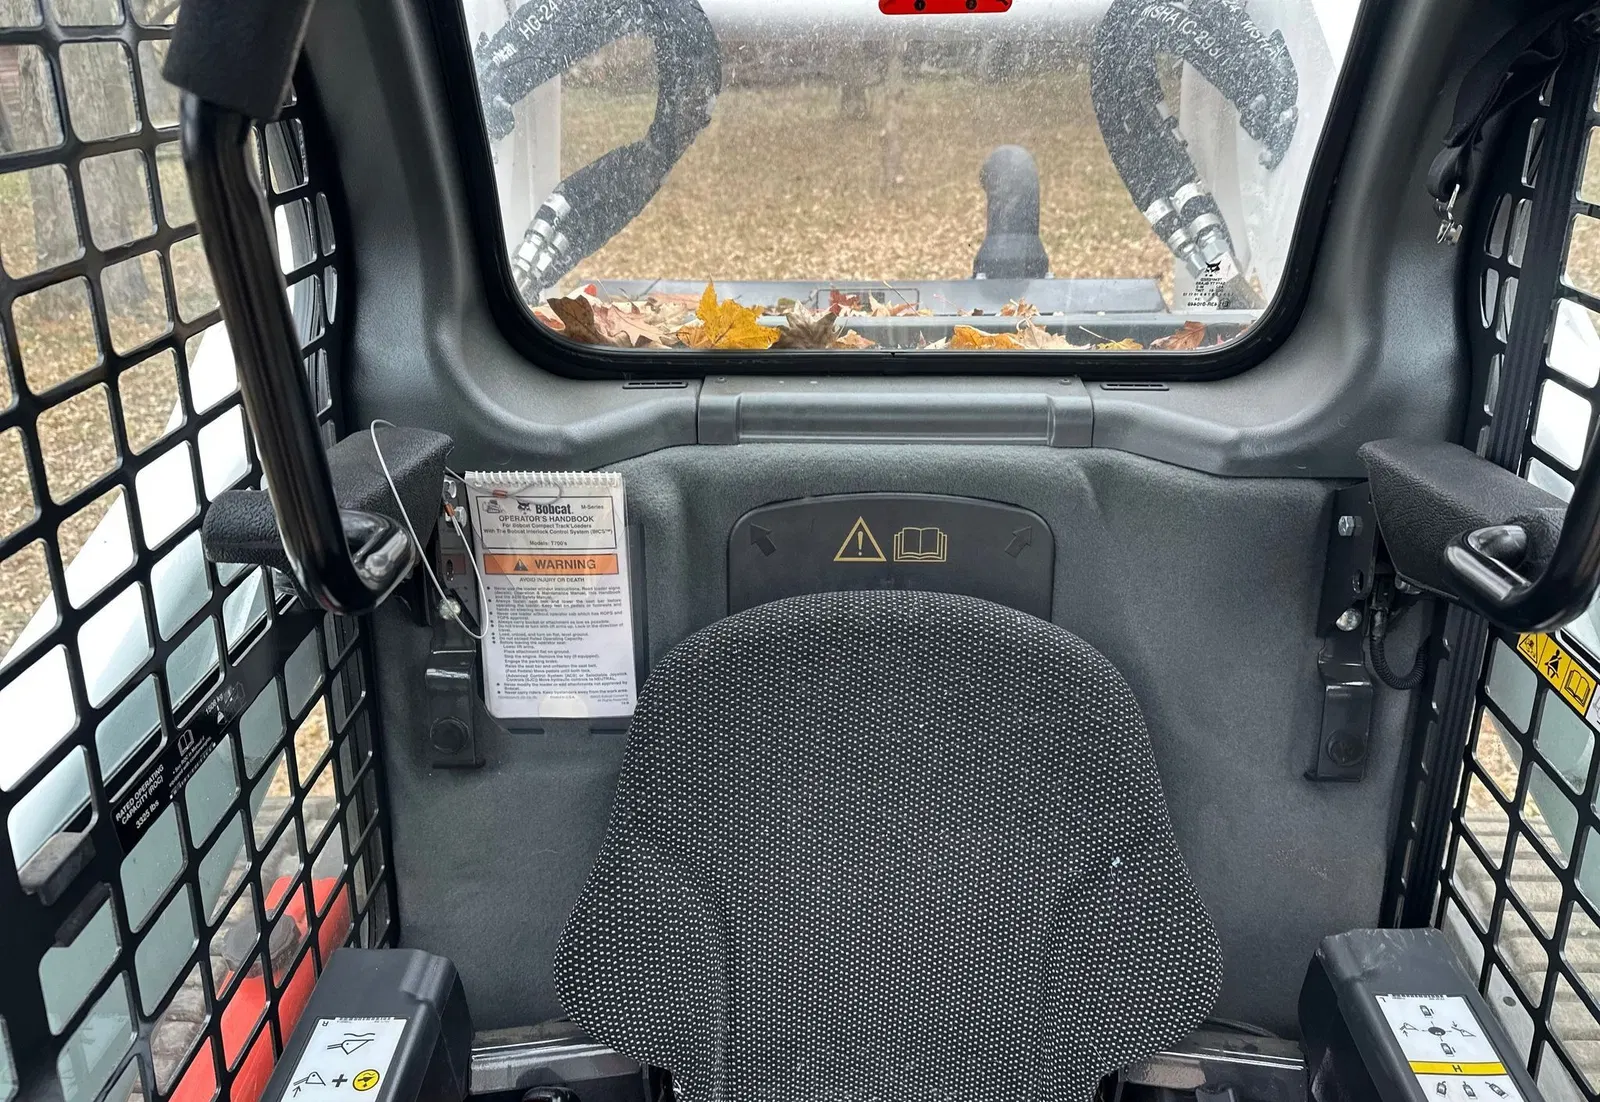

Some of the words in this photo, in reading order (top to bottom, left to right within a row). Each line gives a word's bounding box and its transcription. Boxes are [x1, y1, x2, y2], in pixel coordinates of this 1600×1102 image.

[518, 0, 560, 41] HG-24
[1140, 5, 1180, 27] MSHA
[498, 515, 548, 523] OPERATOR'S
[535, 503, 571, 514] Bobcat
[535, 559, 596, 570] WARNING
[115, 797, 135, 822] RATED
[134, 764, 164, 800] OPERATING
[121, 791, 149, 825] CAPACITY
[148, 775, 164, 796] (ROC)
[135, 808, 150, 829] 3325
[149, 800, 160, 812] lbs
[1452, 1064, 1463, 1073] H
